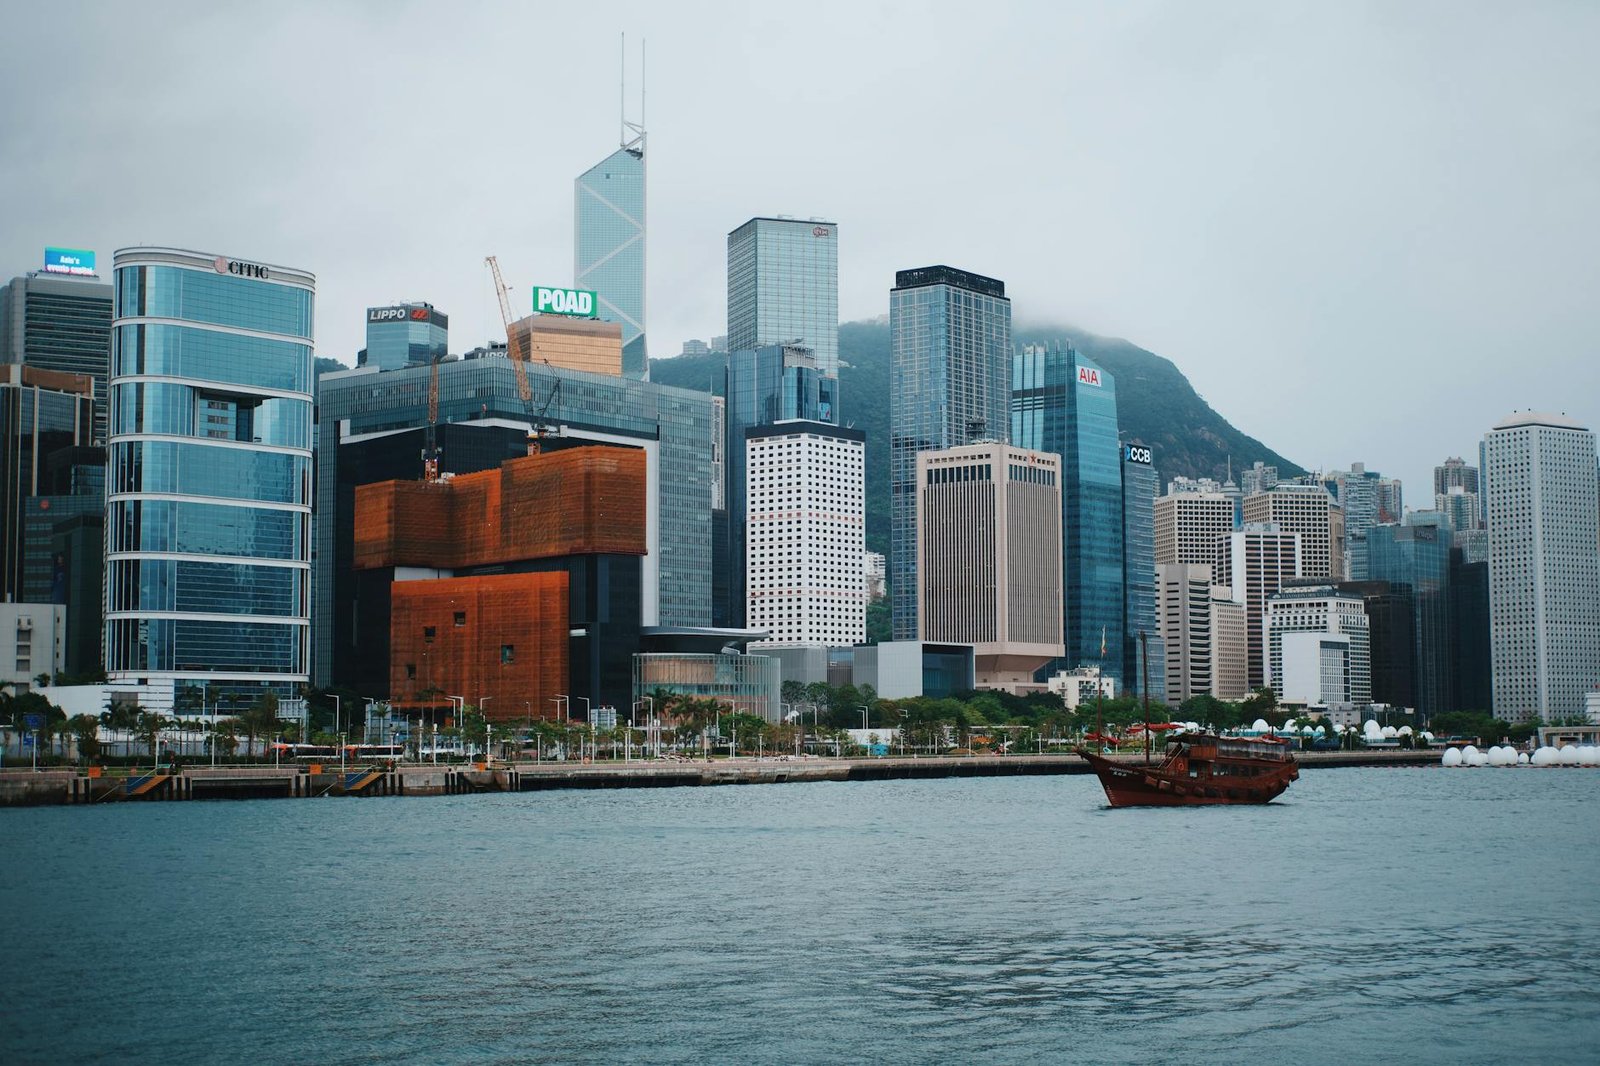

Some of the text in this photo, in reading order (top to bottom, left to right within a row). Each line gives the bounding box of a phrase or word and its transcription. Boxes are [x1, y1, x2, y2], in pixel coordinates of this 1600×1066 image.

[228, 261, 269, 279] CITIC
[538, 288, 592, 314] POAD
[370, 309, 406, 320] LIPPO
[1079, 367, 1099, 385] AIA
[1130, 447, 1151, 463] CCB
